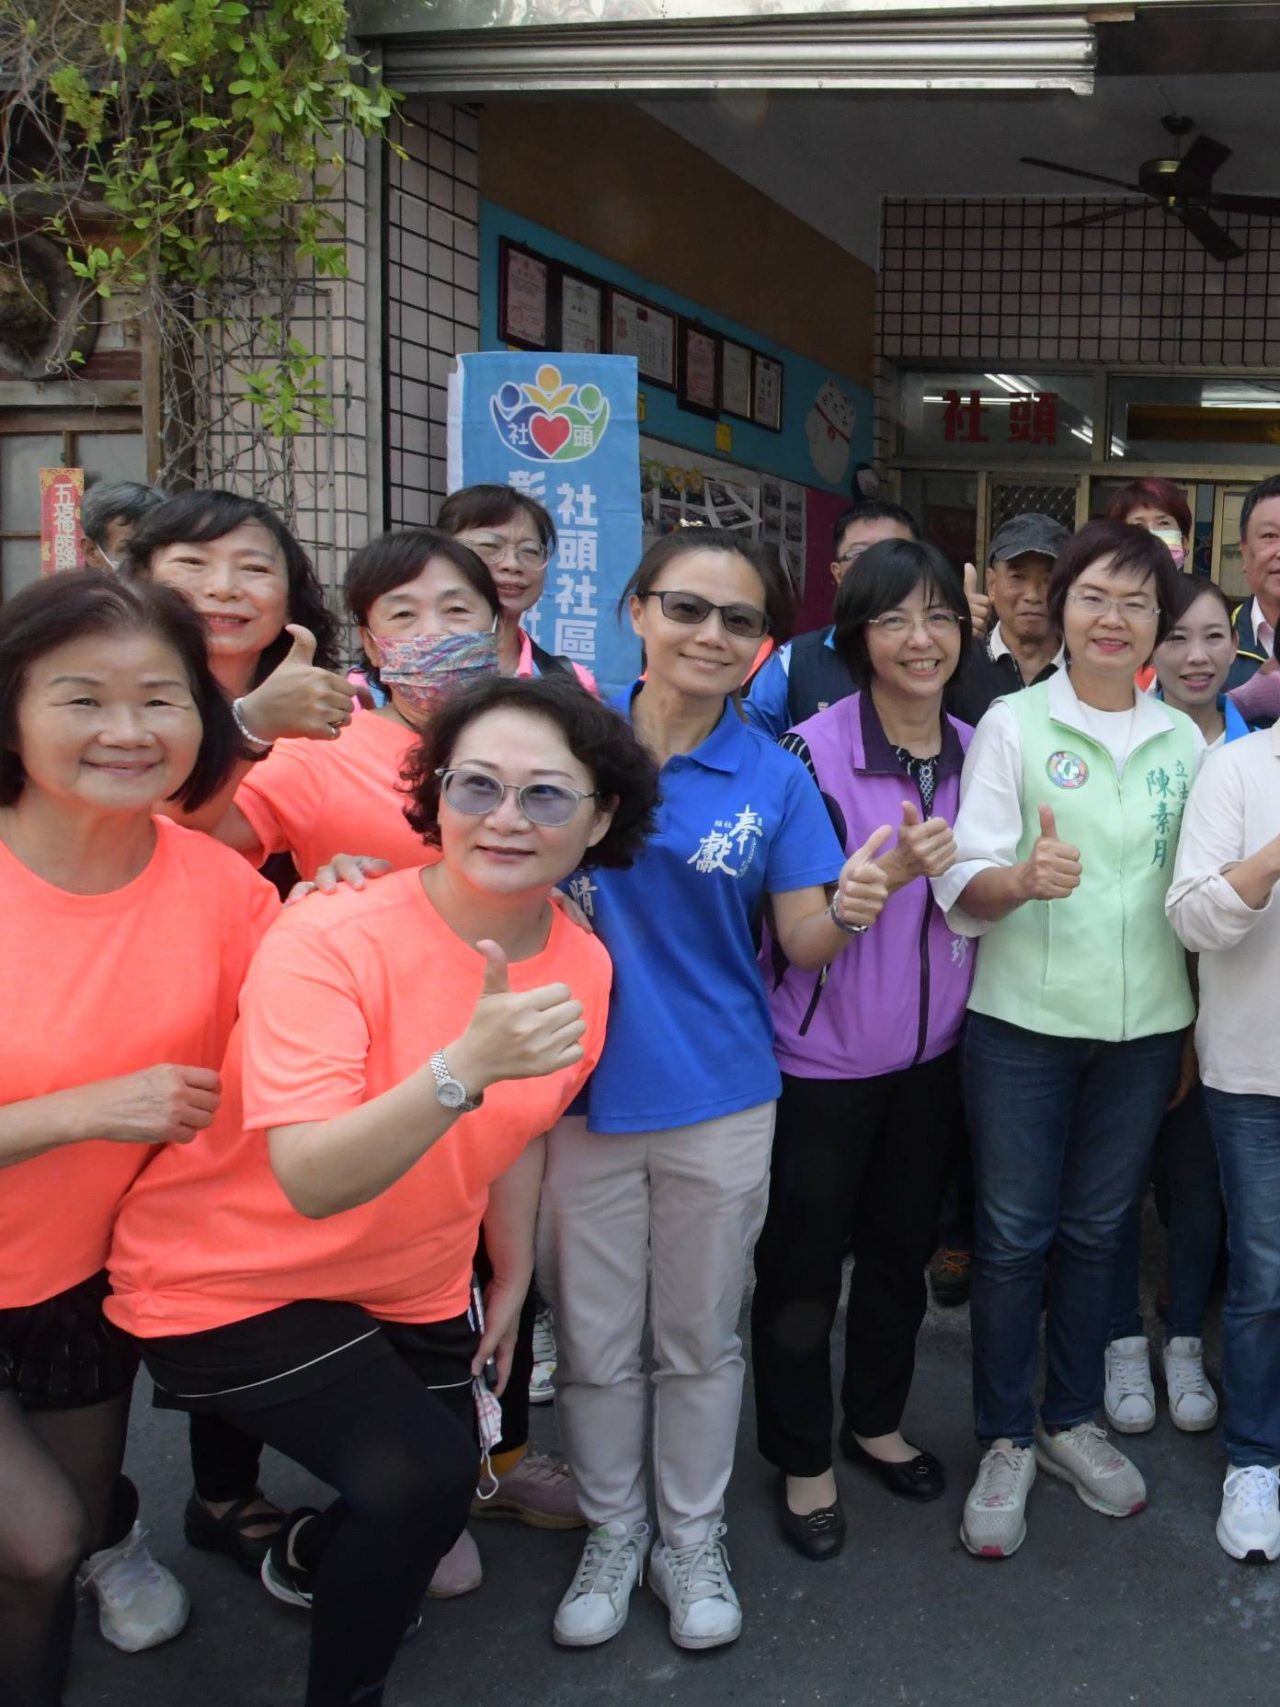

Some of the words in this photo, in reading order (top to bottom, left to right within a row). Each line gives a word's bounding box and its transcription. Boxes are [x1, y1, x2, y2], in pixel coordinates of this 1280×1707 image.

[508, 423, 529, 446] 社
[573, 424, 594, 448] 頭
[943, 389, 1059, 446] 社頭
[554, 482, 598, 661] 社頭社區
[1145, 767, 1176, 869] 陳素月
